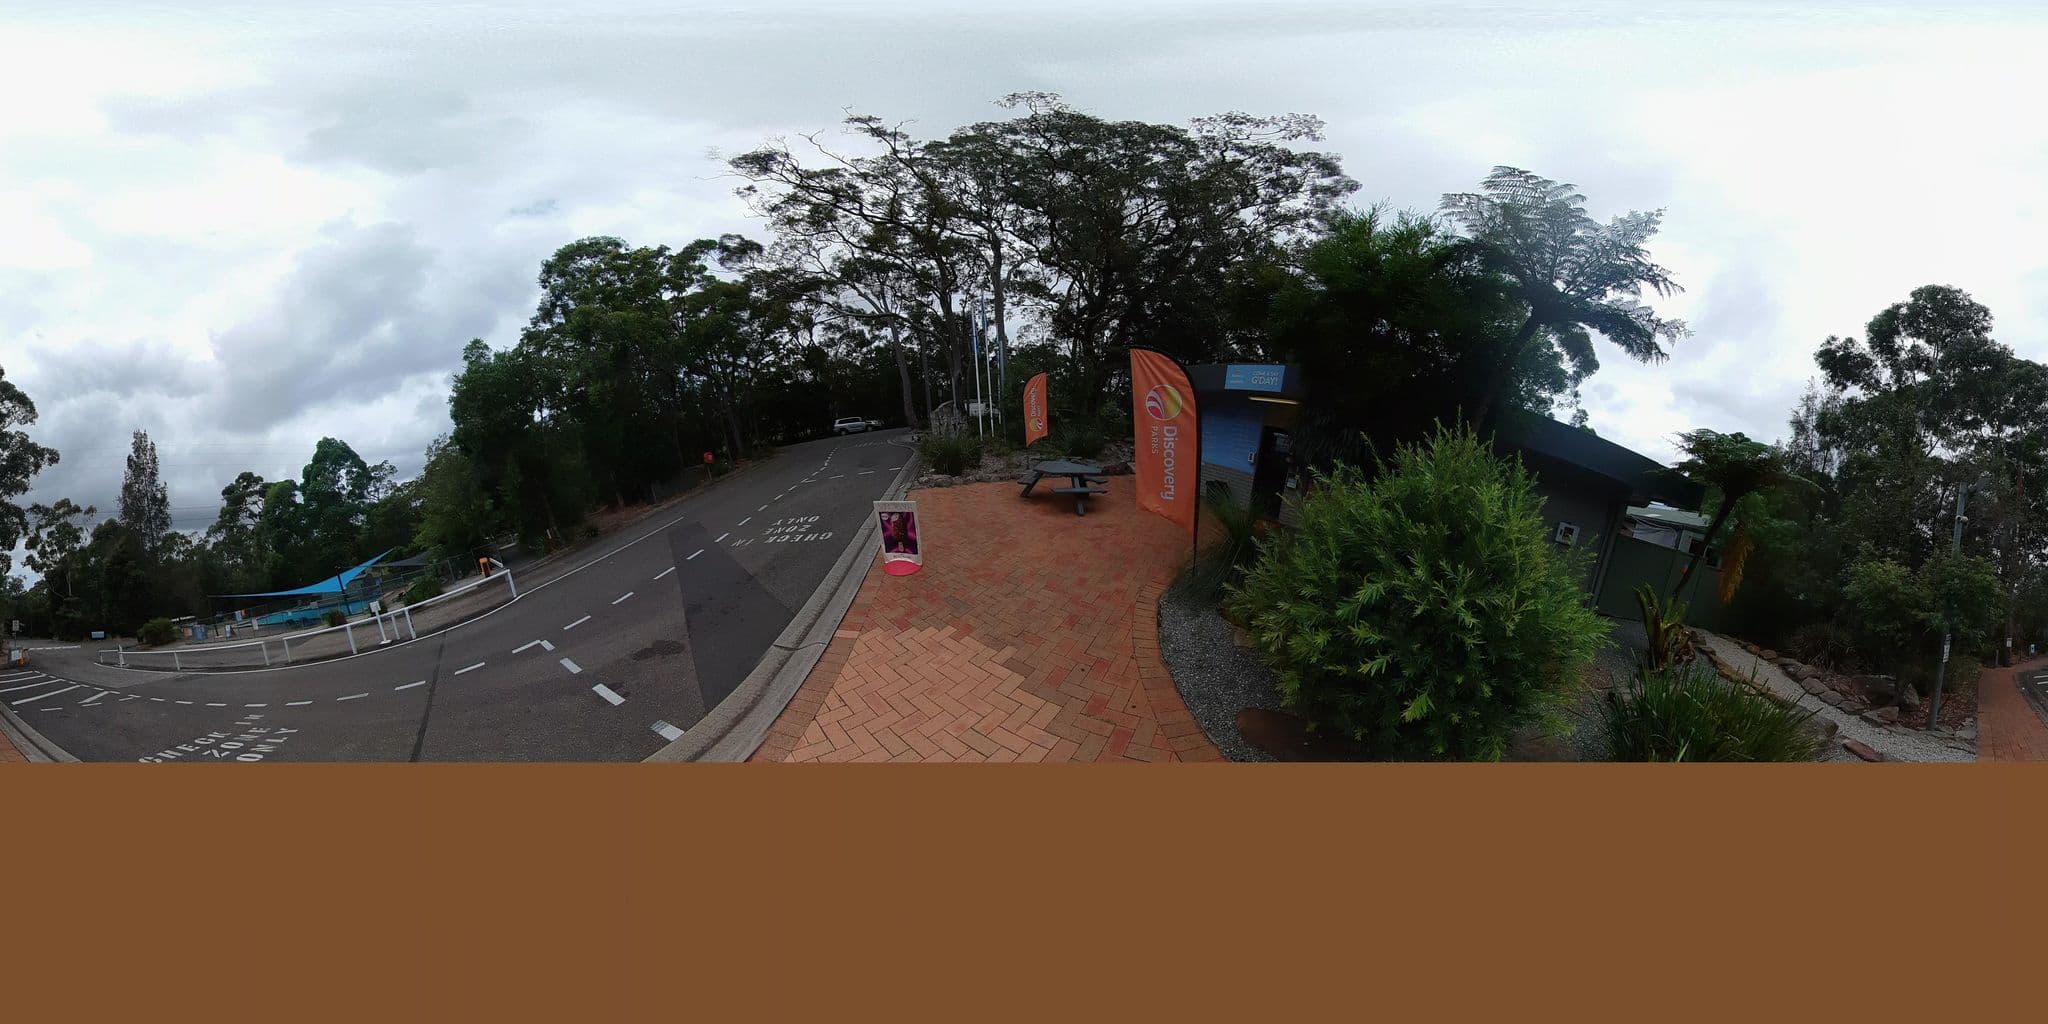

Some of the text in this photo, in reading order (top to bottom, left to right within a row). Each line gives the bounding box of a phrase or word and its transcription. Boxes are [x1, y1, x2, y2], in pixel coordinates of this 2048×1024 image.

[1251, 375, 1279, 386] G'DAY!
[1151, 425, 1159, 454] PARKS
[1161, 425, 1178, 500] Discovery
[762, 525, 811, 535] ZONE
[772, 516, 820, 526] ONLY
[764, 532, 832, 543] CHECK
[138, 731, 231, 763] CHECK
[202, 727, 271, 758] ZONE
[236, 727, 298, 762] ONLY
